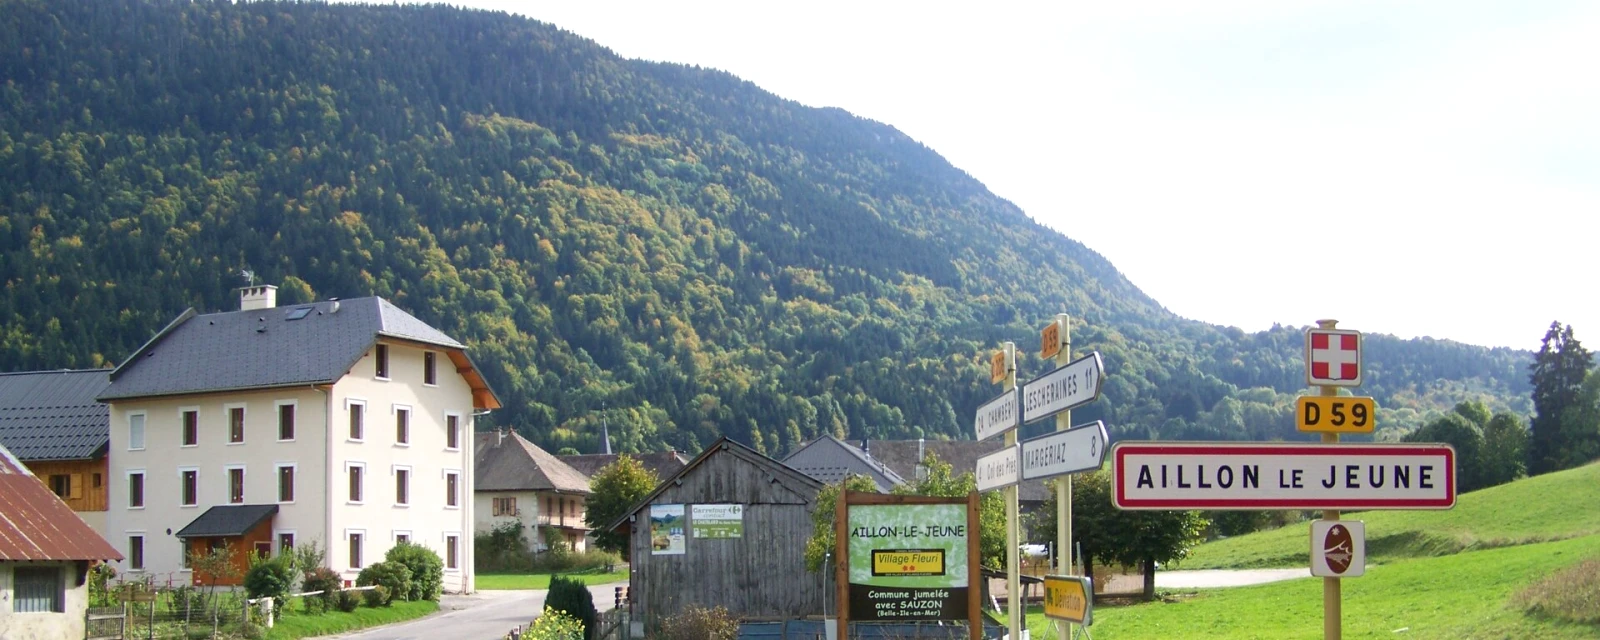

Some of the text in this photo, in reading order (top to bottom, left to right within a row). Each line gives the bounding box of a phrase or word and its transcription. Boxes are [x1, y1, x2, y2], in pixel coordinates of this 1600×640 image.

[1049, 328, 1058, 349] 59
[1026, 367, 1093, 412] LESCHERAINES 11
[988, 398, 1015, 428] CHAMBÉRY
[1304, 401, 1368, 427] D 59
[1025, 435, 1096, 470] MARGÉRIAZ 8
[996, 460, 1004, 478] des
[1136, 464, 1434, 490] AILLON LE JEUNE
[851, 525, 965, 538] AILLON-LE-JEUNE
[878, 553, 938, 565] Village Fleuri
[868, 589, 949, 600] Commune jumelée
[900, 600, 942, 609] SAUZON
[1054, 587, 1081, 612] Déviation
[877, 609, 941, 618] (Belle-Ile-en-Mer)
